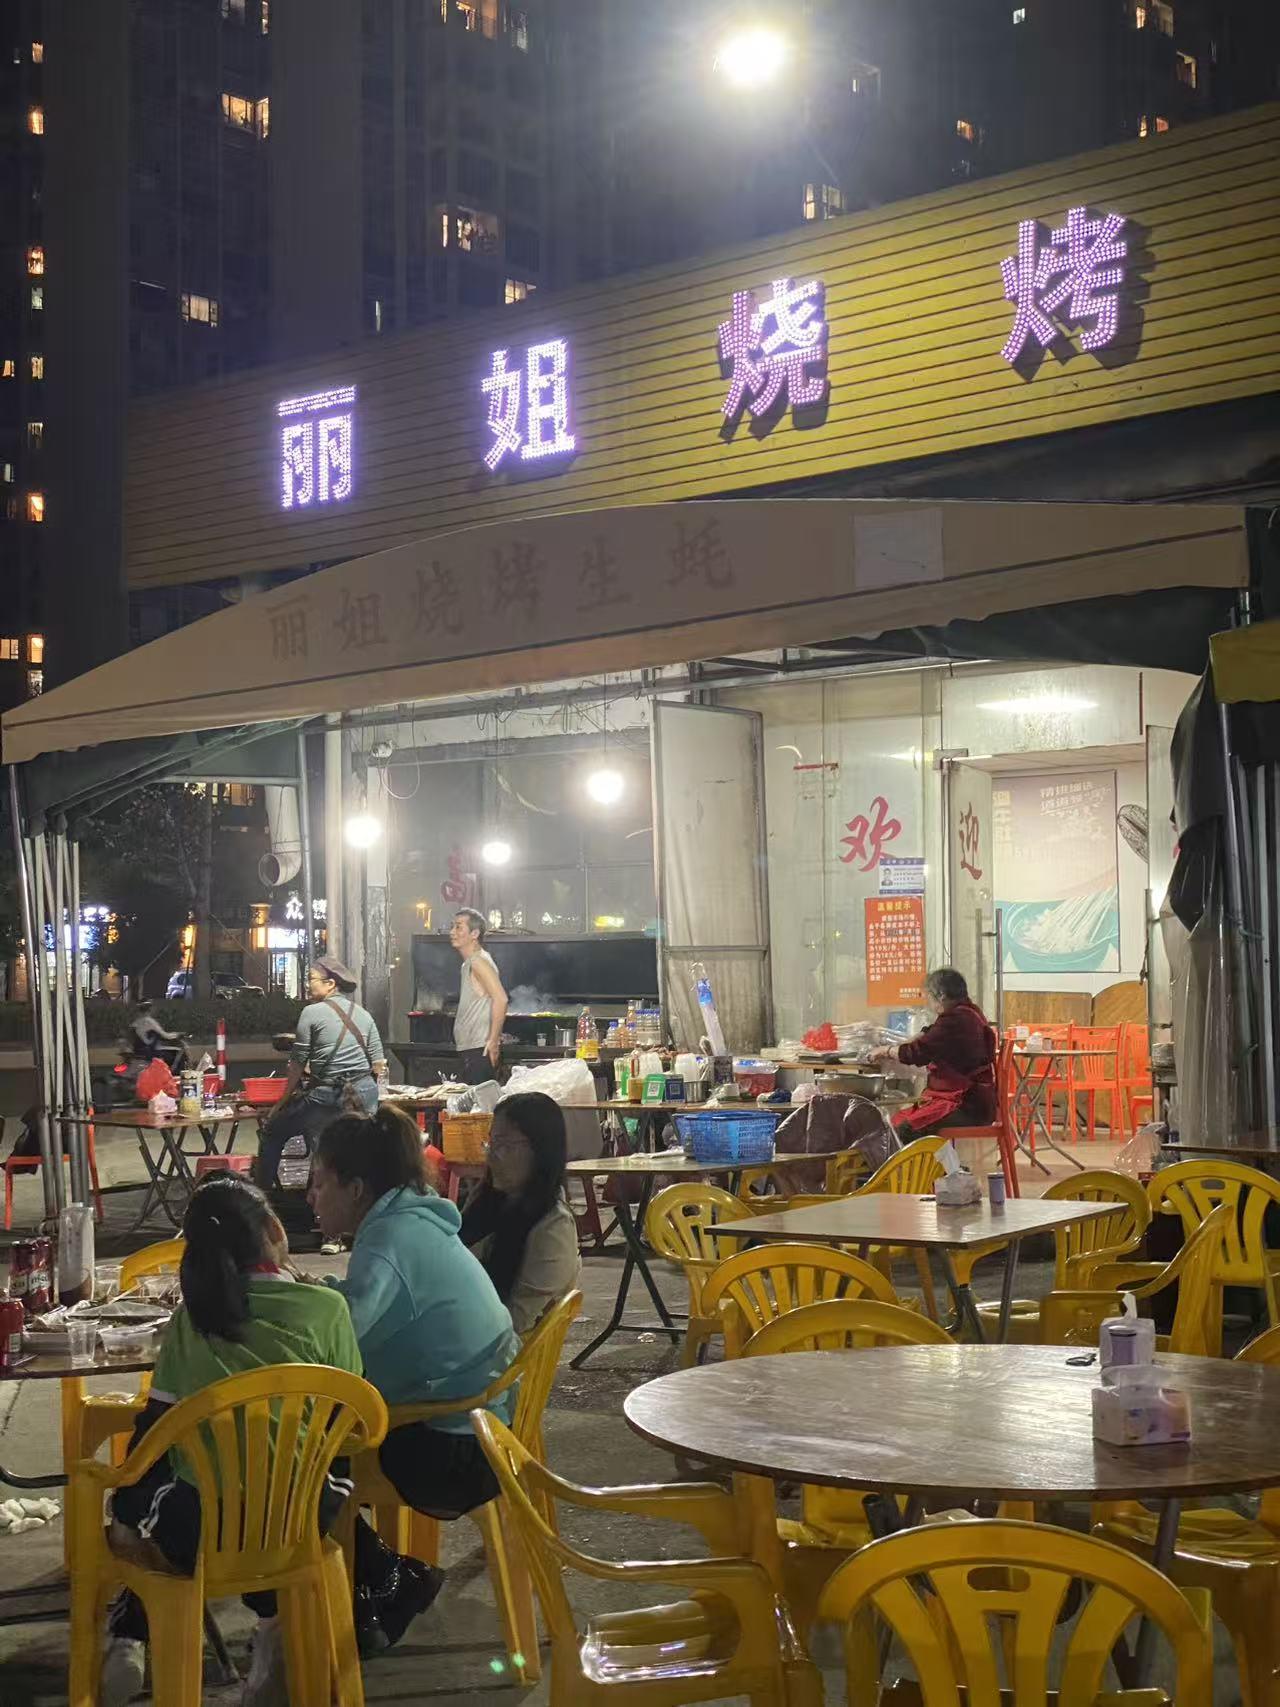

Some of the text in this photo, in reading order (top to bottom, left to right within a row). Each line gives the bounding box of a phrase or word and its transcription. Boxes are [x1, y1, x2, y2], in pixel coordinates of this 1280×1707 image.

[276, 205, 1127, 510] 丽姐烧烤
[265, 515, 737, 659] 丽姐烧烤生蚝
